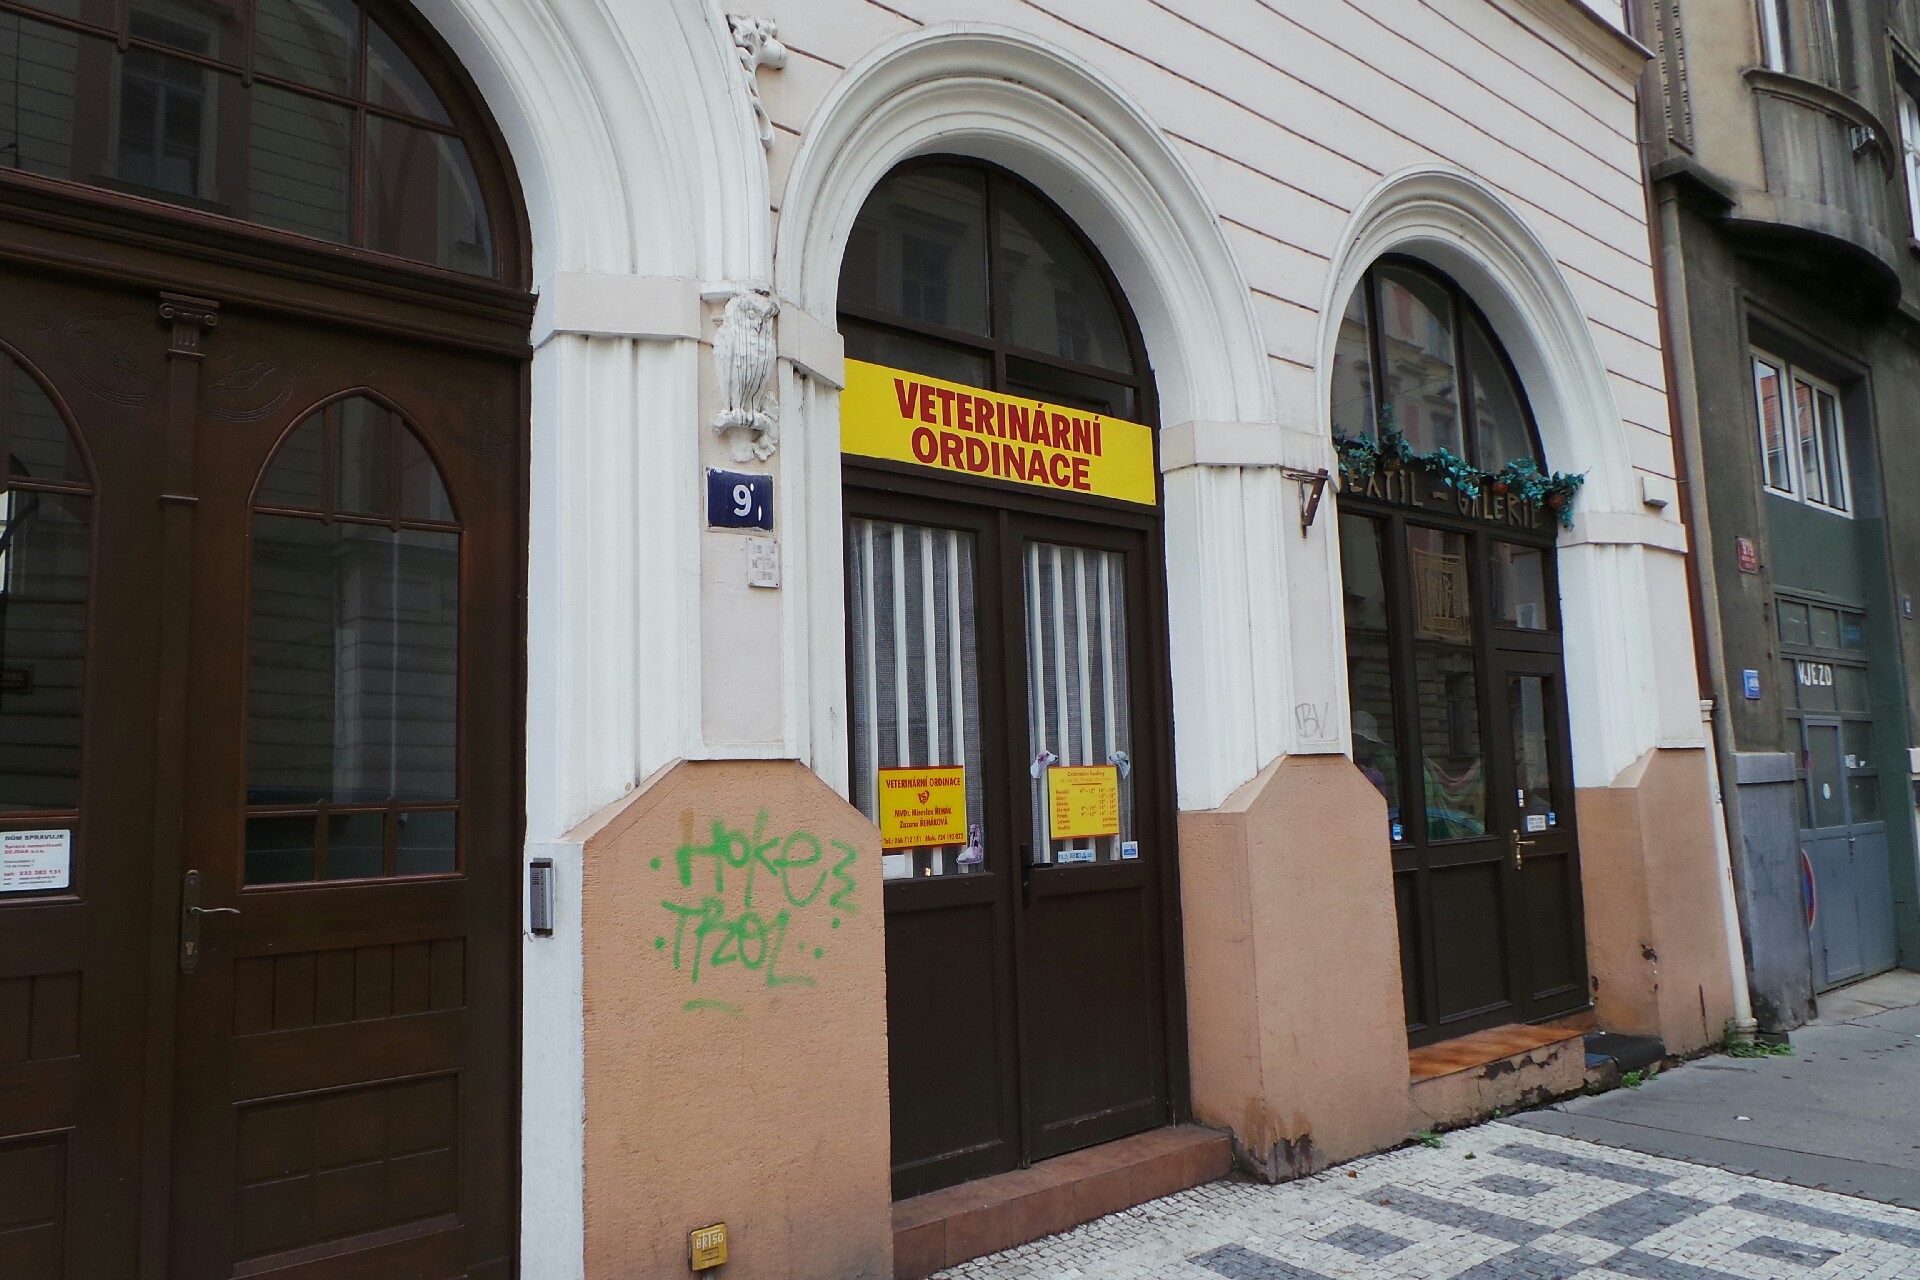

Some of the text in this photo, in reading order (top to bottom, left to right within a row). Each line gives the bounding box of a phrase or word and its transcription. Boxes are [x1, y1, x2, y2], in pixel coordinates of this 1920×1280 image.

[893, 377, 1103, 457] VETERINÁRNÍ
[911, 426, 1092, 491] ORDINACE
[732, 483, 752, 517] 9
[886, 776, 960, 788] VETERINÁRNÍ ORDINACE
